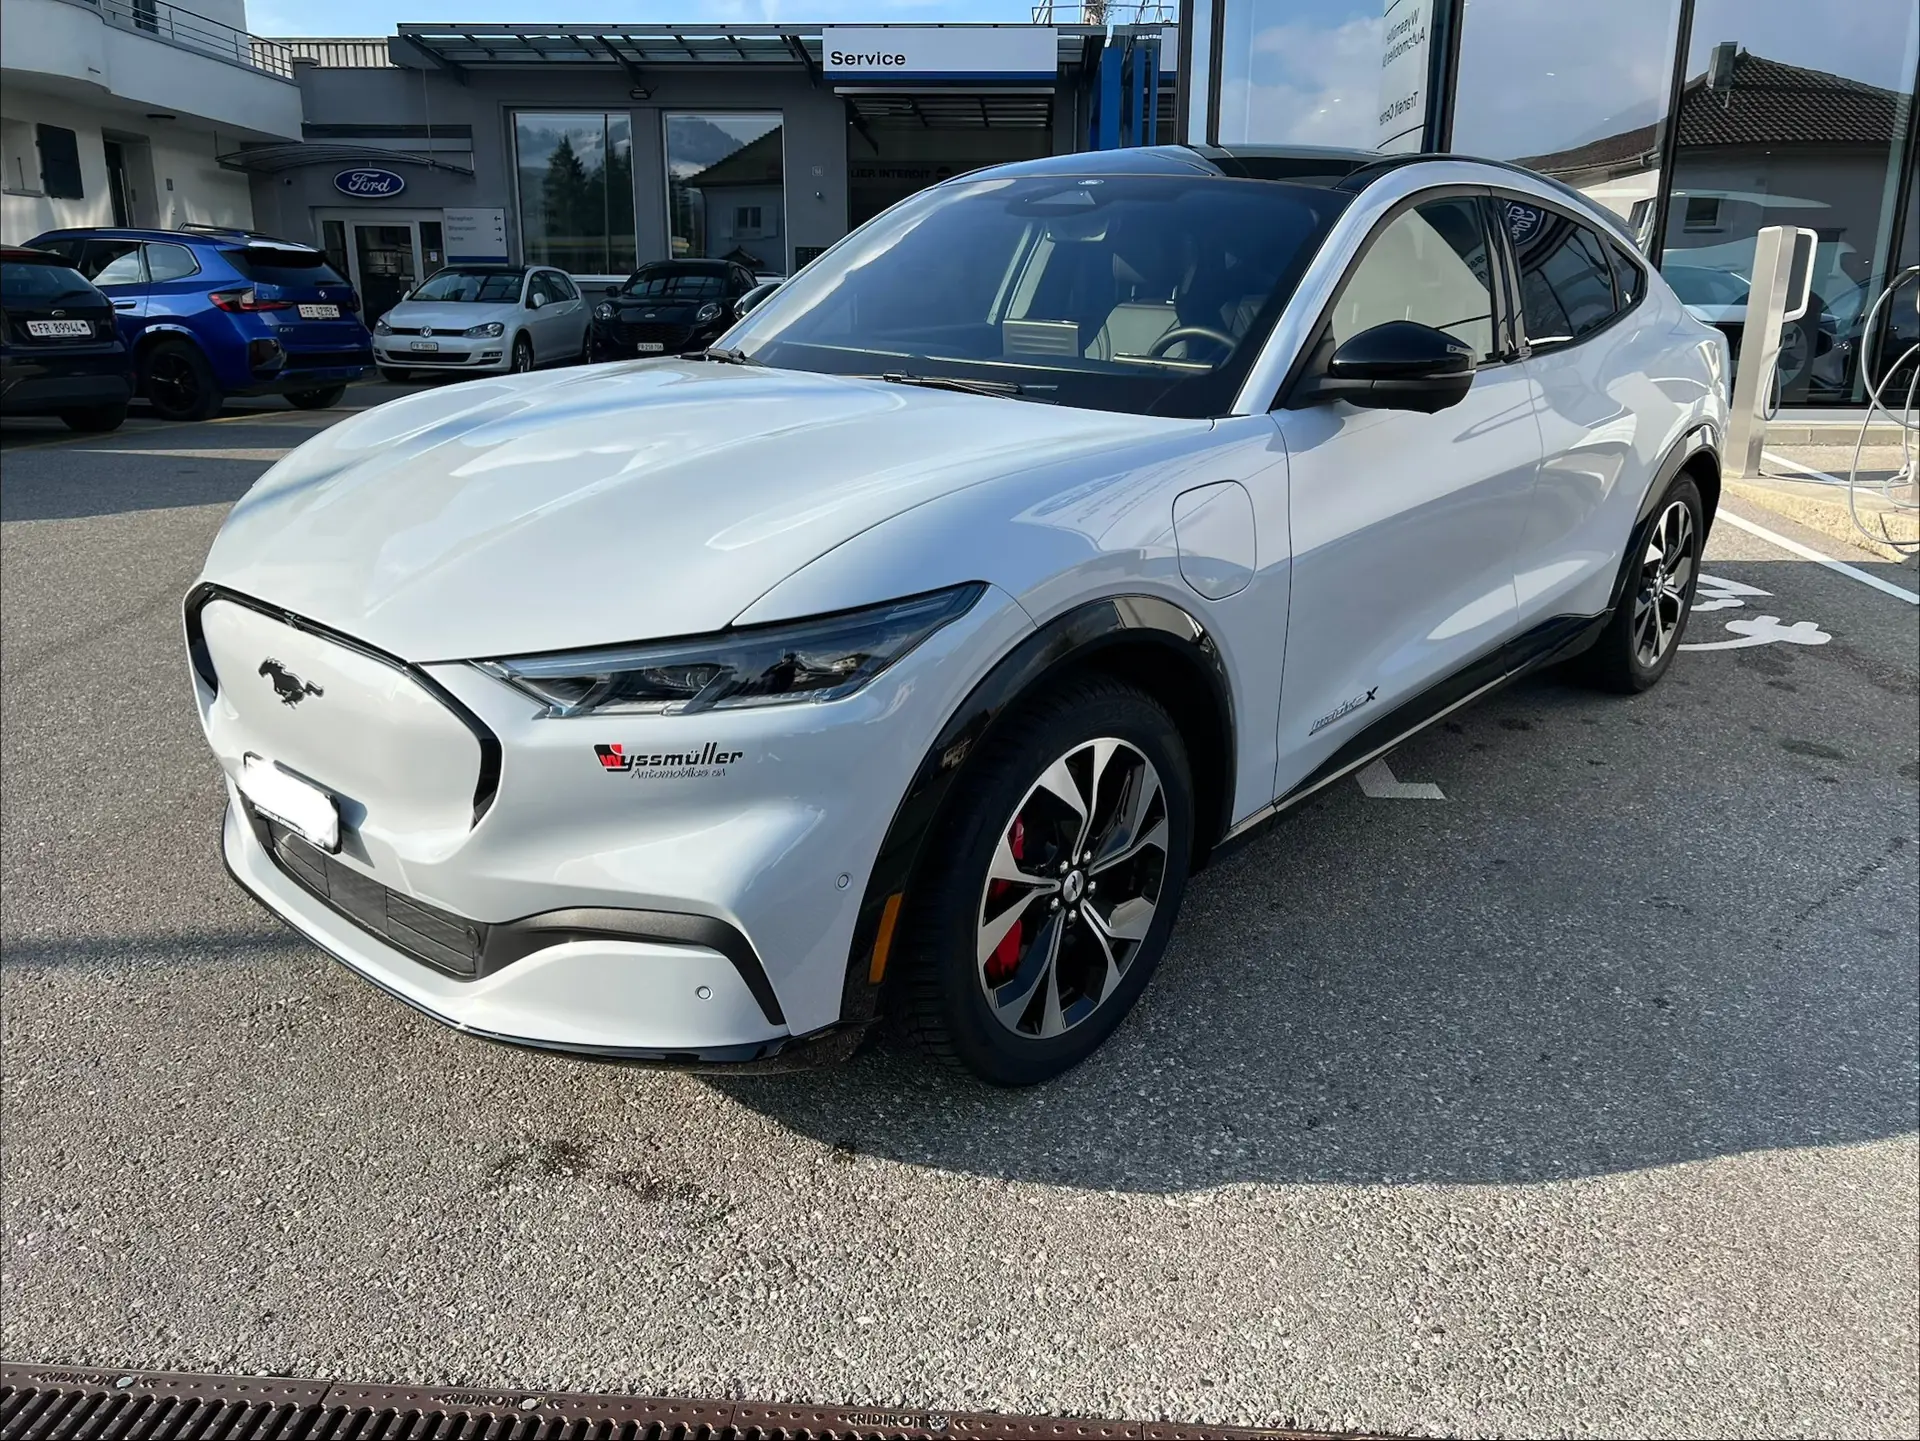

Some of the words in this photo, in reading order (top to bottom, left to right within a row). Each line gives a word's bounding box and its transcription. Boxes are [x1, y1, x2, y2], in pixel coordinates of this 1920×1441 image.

[830, 50, 906, 66] Service
[879, 168, 931, 180] INTERDIT
[348, 172, 391, 193] Ford
[37, 323, 52, 334] FR
[53, 322, 82, 334] 89944
[594, 742, 743, 772] Wyssmüller
[630, 767, 709, 780] Automobiles
[847, 1412, 925, 1430] GRIDIRON
